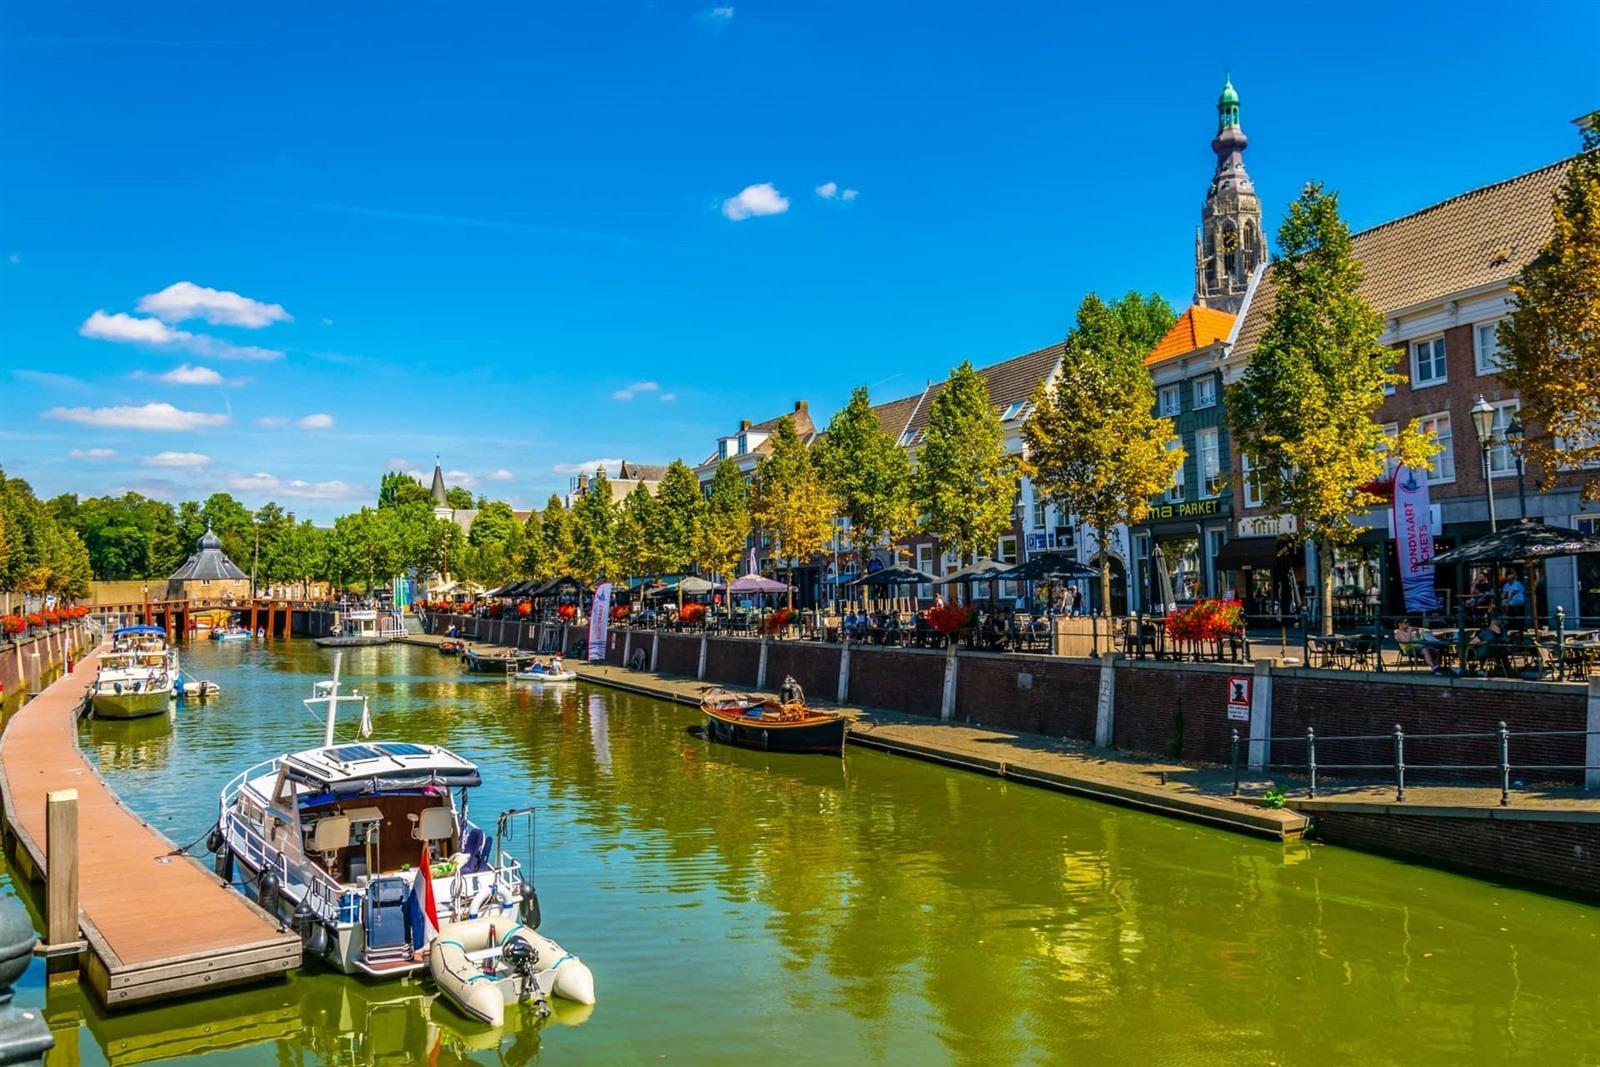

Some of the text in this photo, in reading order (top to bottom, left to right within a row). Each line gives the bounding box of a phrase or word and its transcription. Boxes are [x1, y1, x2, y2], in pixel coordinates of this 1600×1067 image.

[1179, 501, 1217, 516] PARKET
[1404, 502, 1419, 573] RONDVAART
[1418, 525, 1430, 572] TCKETS
